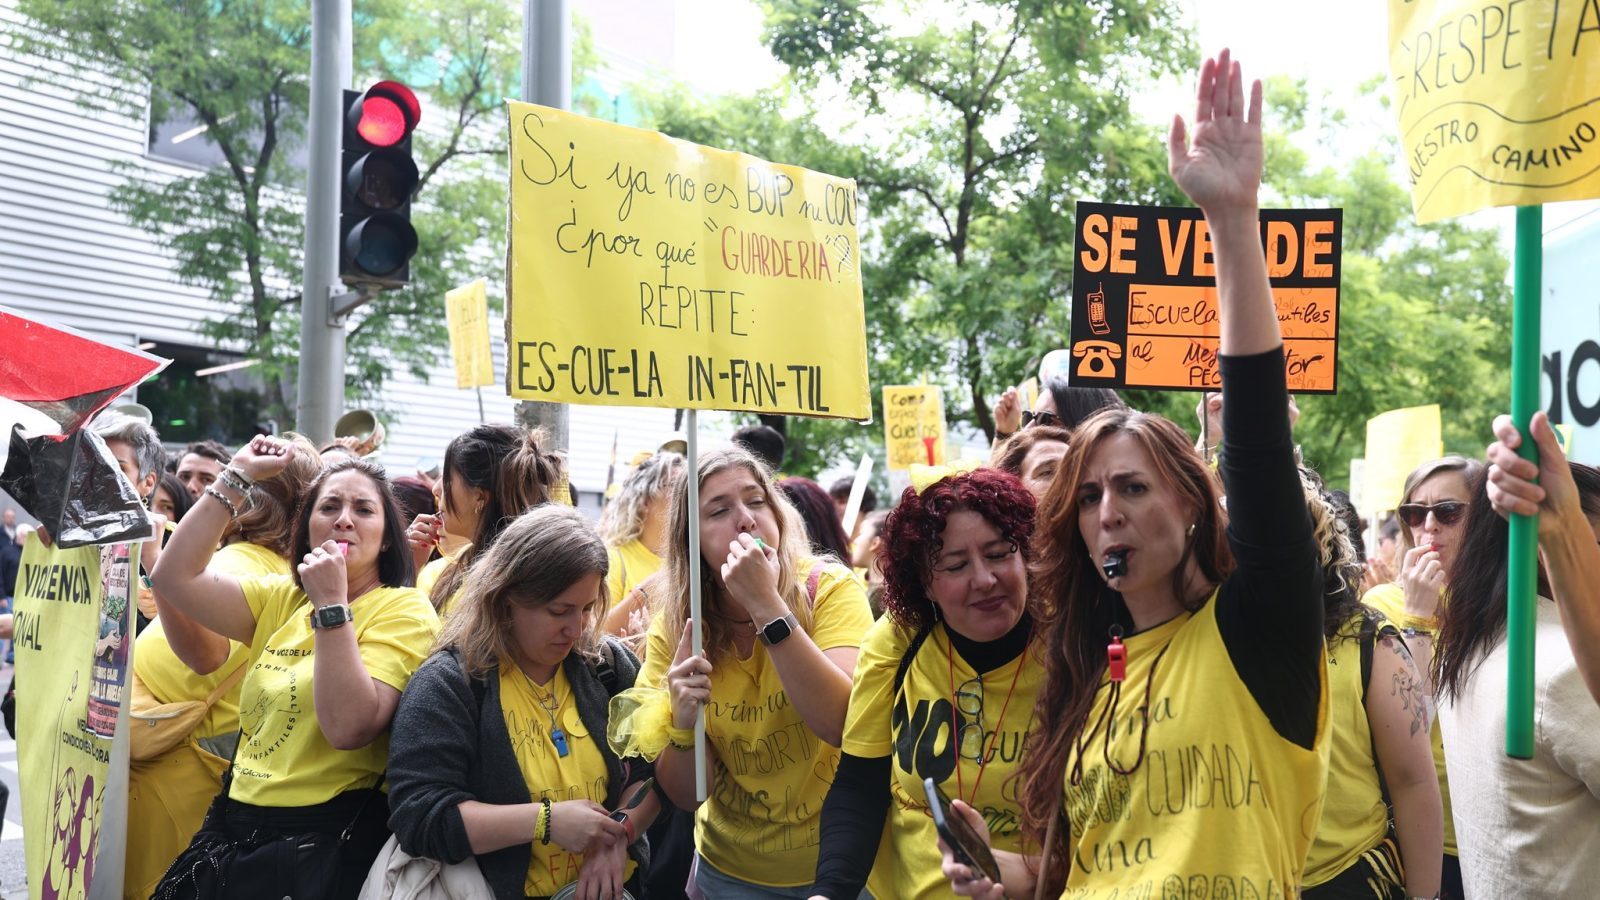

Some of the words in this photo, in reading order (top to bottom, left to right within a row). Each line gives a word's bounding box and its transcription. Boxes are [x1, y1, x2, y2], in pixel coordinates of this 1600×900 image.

[520, 112, 587, 190] Si
[606, 161, 656, 222] ya
[664, 171, 696, 202] no
[703, 182, 740, 210] es
[746, 167, 794, 218] BUP
[1492, 121, 1597, 172] CAMINO
[556, 199, 643, 268] ¿por
[656, 241, 698, 290] qué
[1080, 213, 1139, 275] SE
[1157, 218, 1335, 279] VEDE
[640, 281, 756, 337] REPITE:
[1130, 290, 1221, 327] Escuela
[517, 342, 664, 399] ES-CUE-LA
[687, 354, 830, 412] IN-FAN-TIL
[1285, 348, 1326, 376] tor
[255, 663, 288, 673] ORMA
[289, 649, 300, 657] DE
[249, 716, 297, 760] INFANTILES
[892, 697, 966, 785] NO
[1146, 743, 1269, 817] CUIDADA
